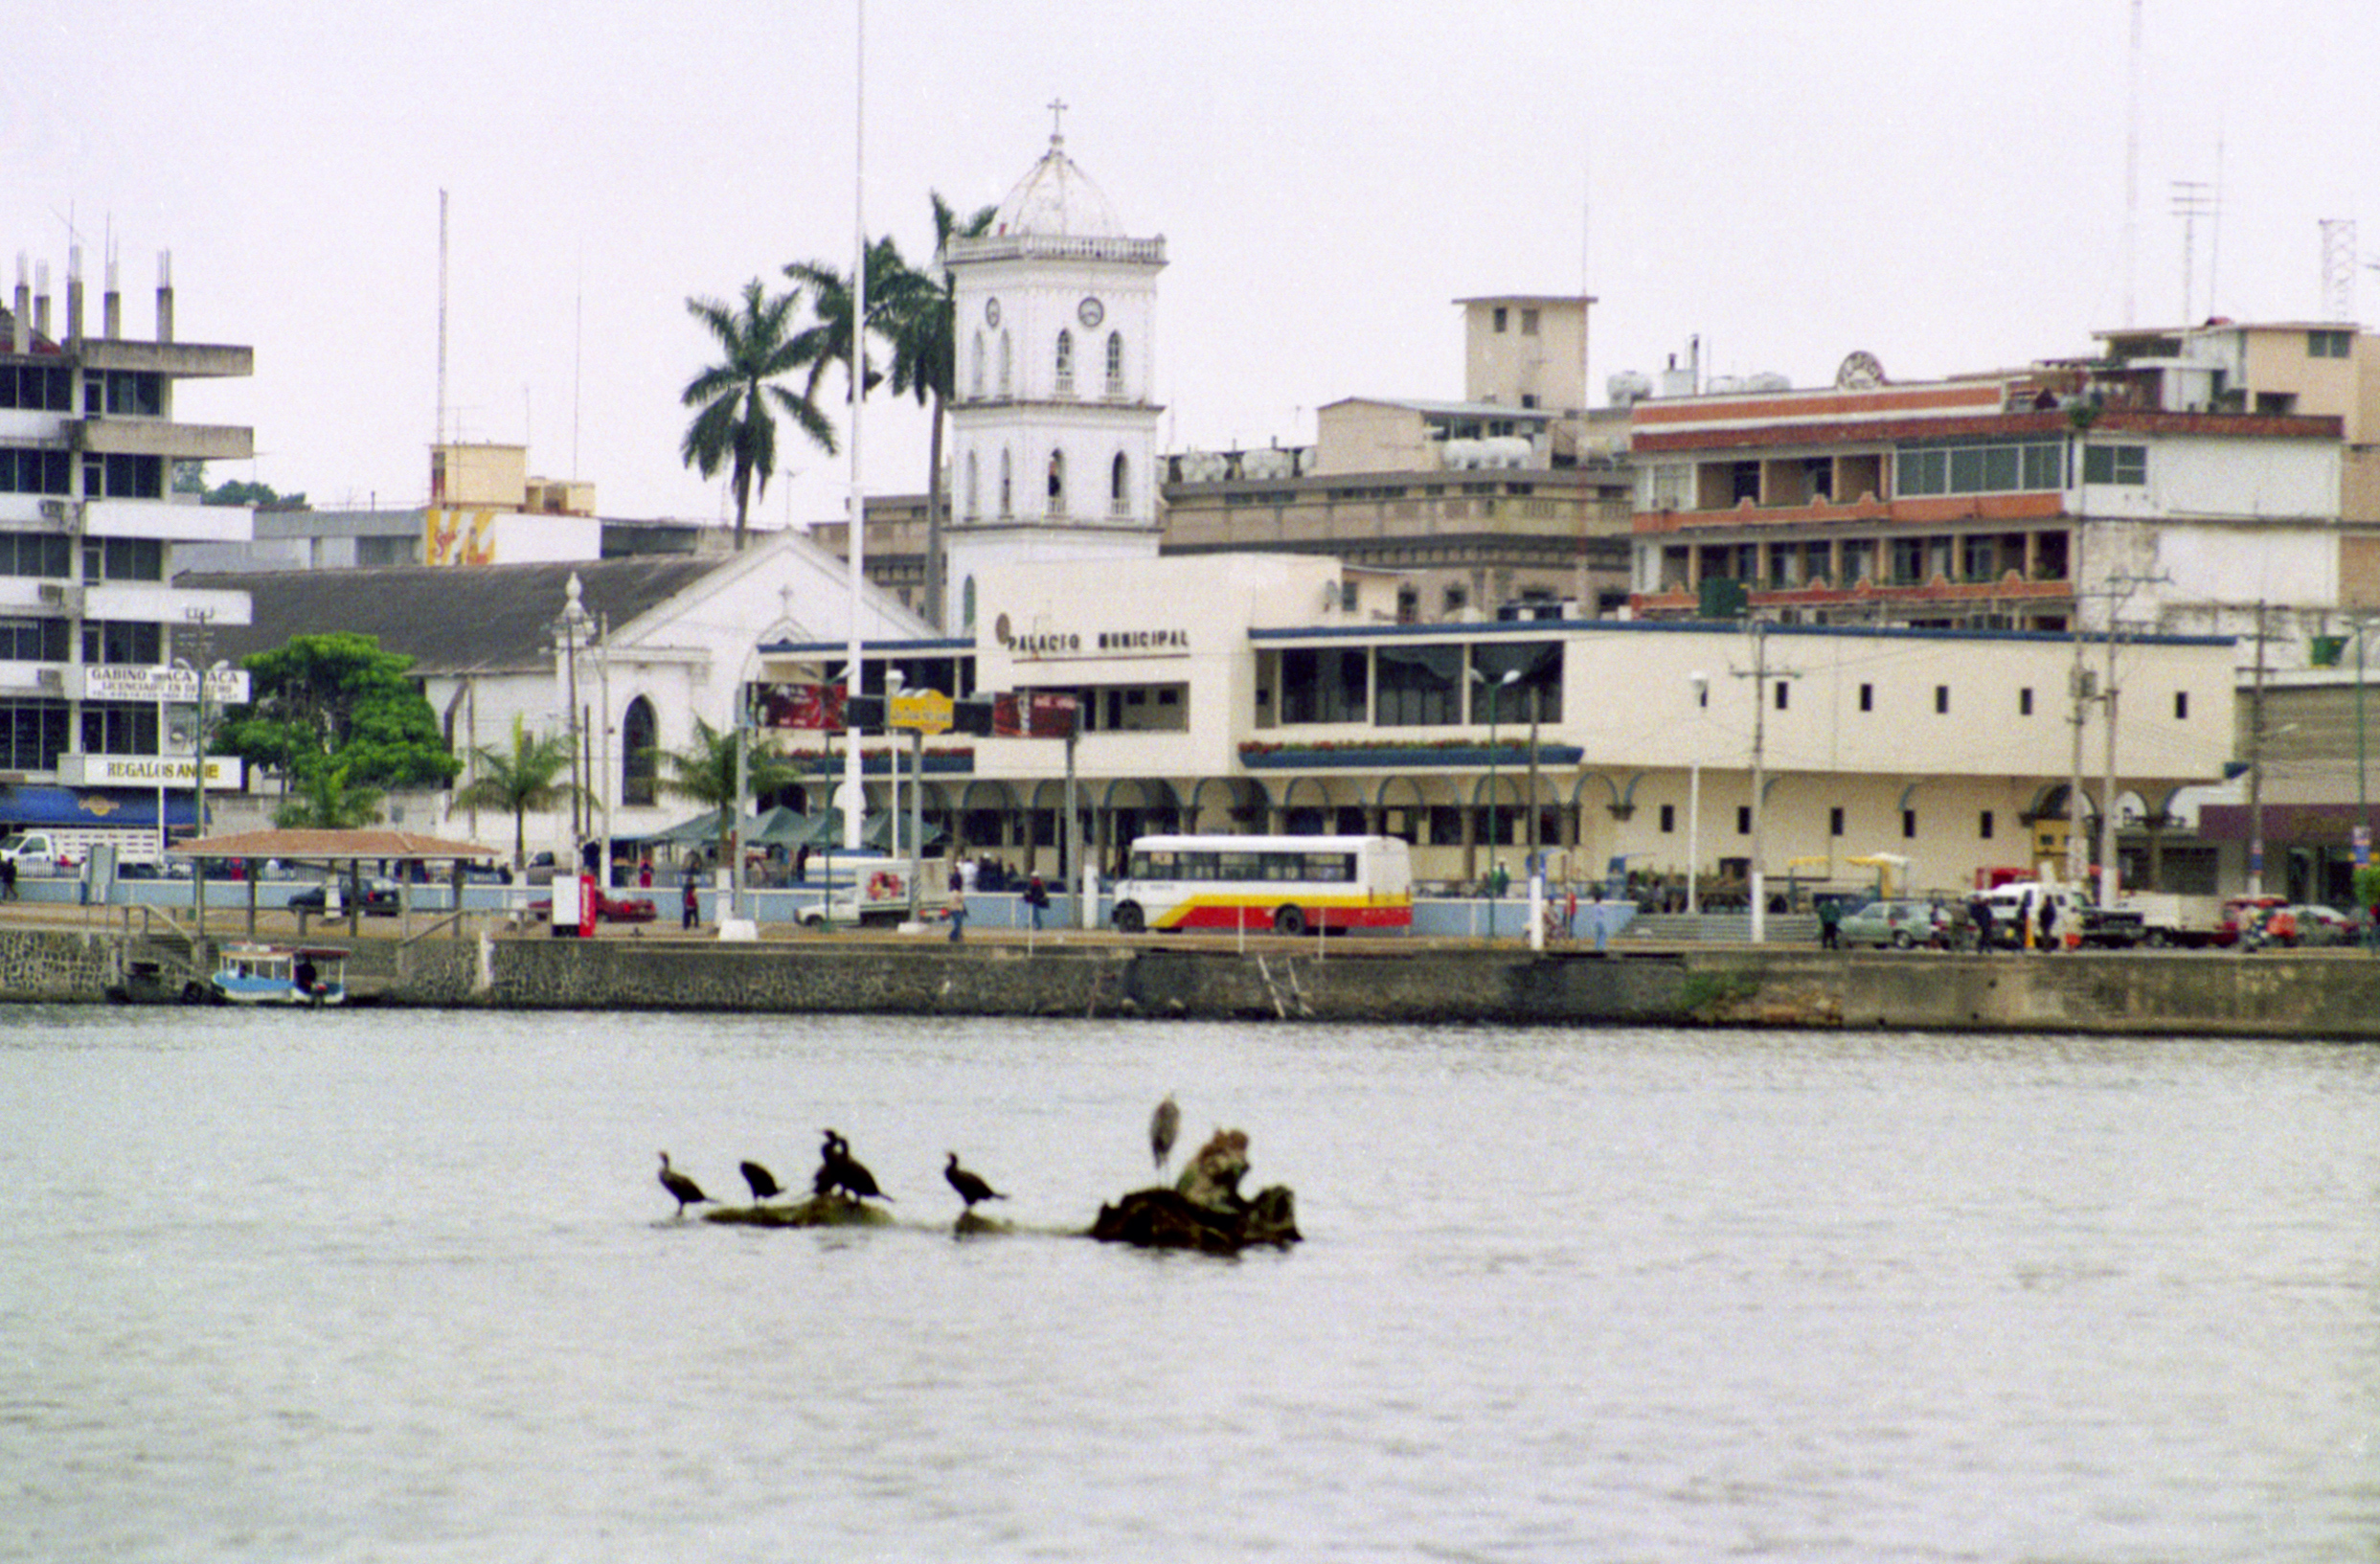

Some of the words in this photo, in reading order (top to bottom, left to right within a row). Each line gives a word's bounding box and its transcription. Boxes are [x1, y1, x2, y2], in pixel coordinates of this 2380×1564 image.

[1009, 634, 1079, 651] PALACIO
[1098, 630, 1189, 649] MUNICIPAL
[92, 669, 147, 680] GABINO
[185, 684, 232, 693] DEECHO
